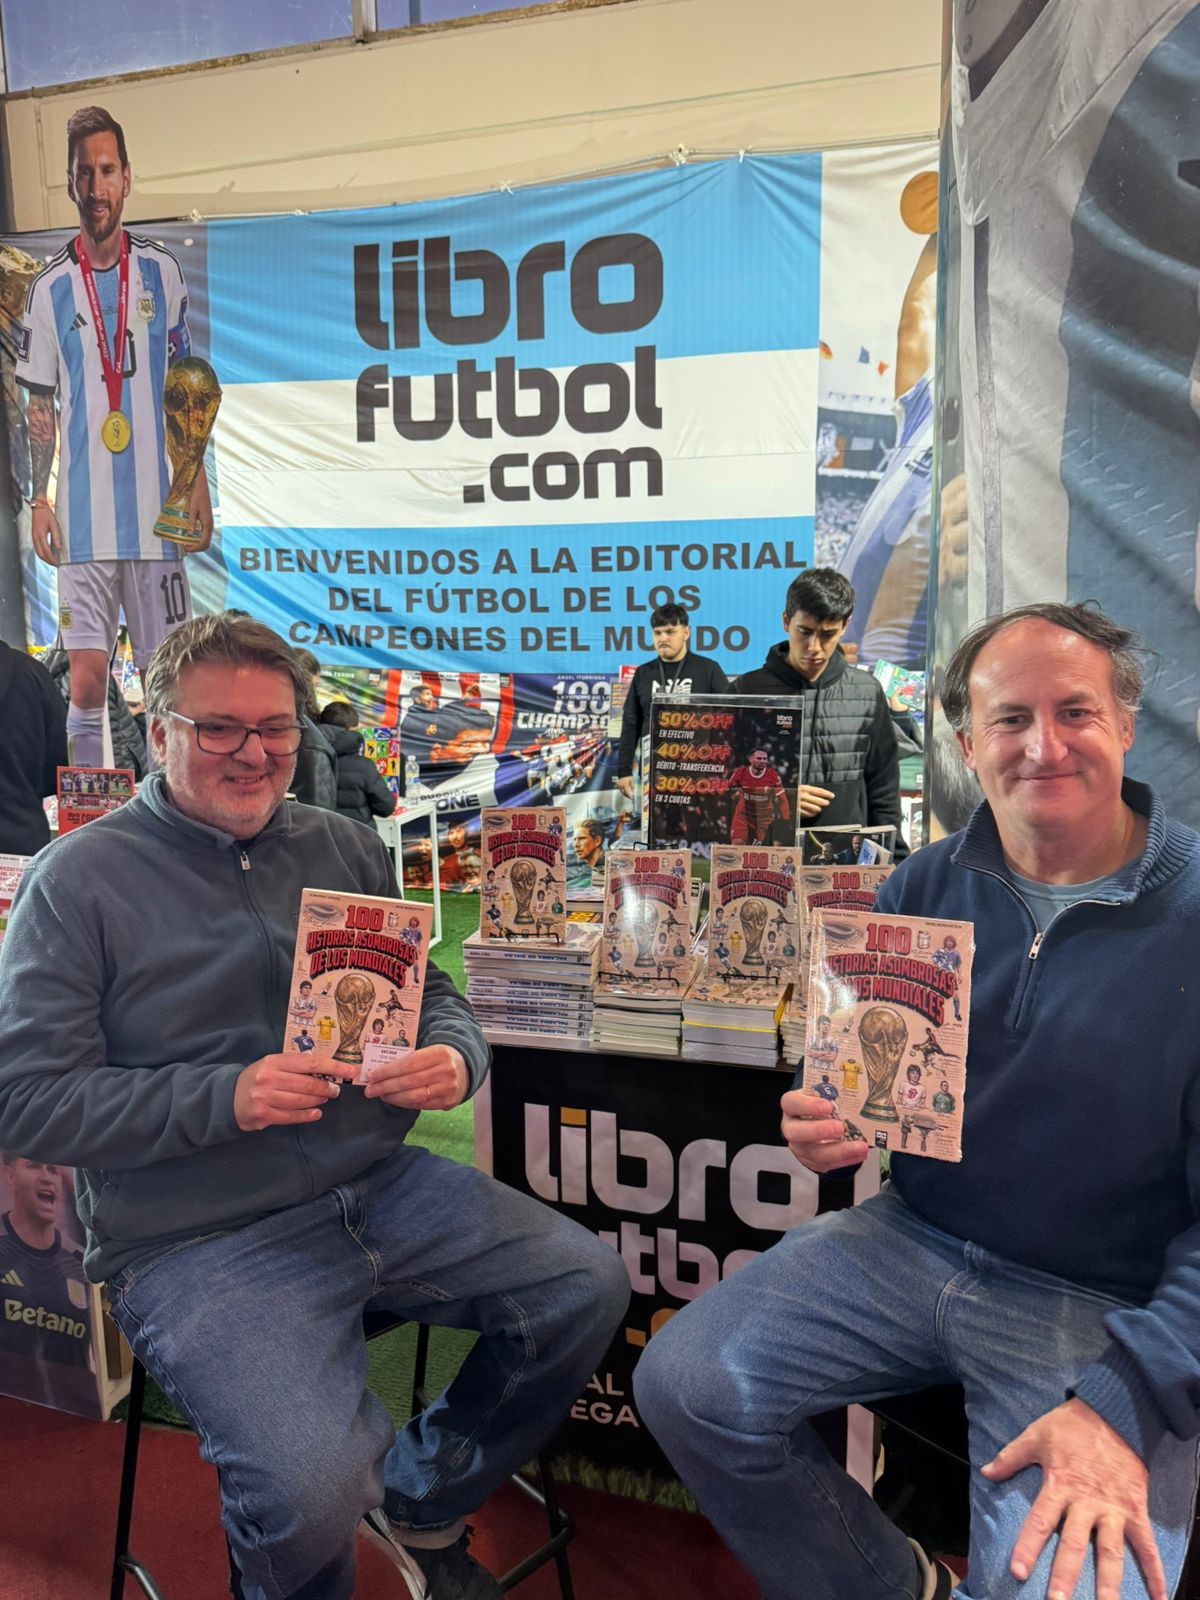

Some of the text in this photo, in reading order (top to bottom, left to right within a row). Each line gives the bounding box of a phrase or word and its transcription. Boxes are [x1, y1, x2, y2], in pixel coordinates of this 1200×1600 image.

[354, 233, 663, 351] libro
[356, 345, 662, 442] futbol
[463, 446, 663, 503] .com
[240, 541, 807, 575] BIENVENIDOS A LA EDITORIAL
[160, 572, 186, 624] 10
[328, 582, 702, 613] DEL FÚTBOL DE LOS
[289, 621, 751, 652] CAMPEONES DEL MUDO
[553, 681, 611, 714] 100
[659, 730, 695, 739] EN EFECTIVO
[655, 794, 691, 804] EN 3 CUOTAS
[512, 814, 536, 830] 100
[634, 857, 660, 873] 100
[742, 852, 769, 869] 100
[717, 870, 750, 889] HISTORIAS
[750, 870, 793, 891] ASOMBROSAS
[721, 886, 733, 906] DE
[732, 883, 746, 899] LOS
[747, 883, 788, 908] MUNDIALES
[832, 872, 860, 889] 100
[346, 905, 384, 932] 100
[306, 930, 416, 966] HISTORIAS ASOMBROSAS
[866, 923, 912, 955] 100
[310, 950, 406, 988] DE LOS MUNDIALES
[879, 955, 954, 999] ASOMBROSAS
[873, 977, 944, 1027] MUNDIALES
[524, 1102, 819, 1231] libro
[5, 1298, 86, 1338] Betano
